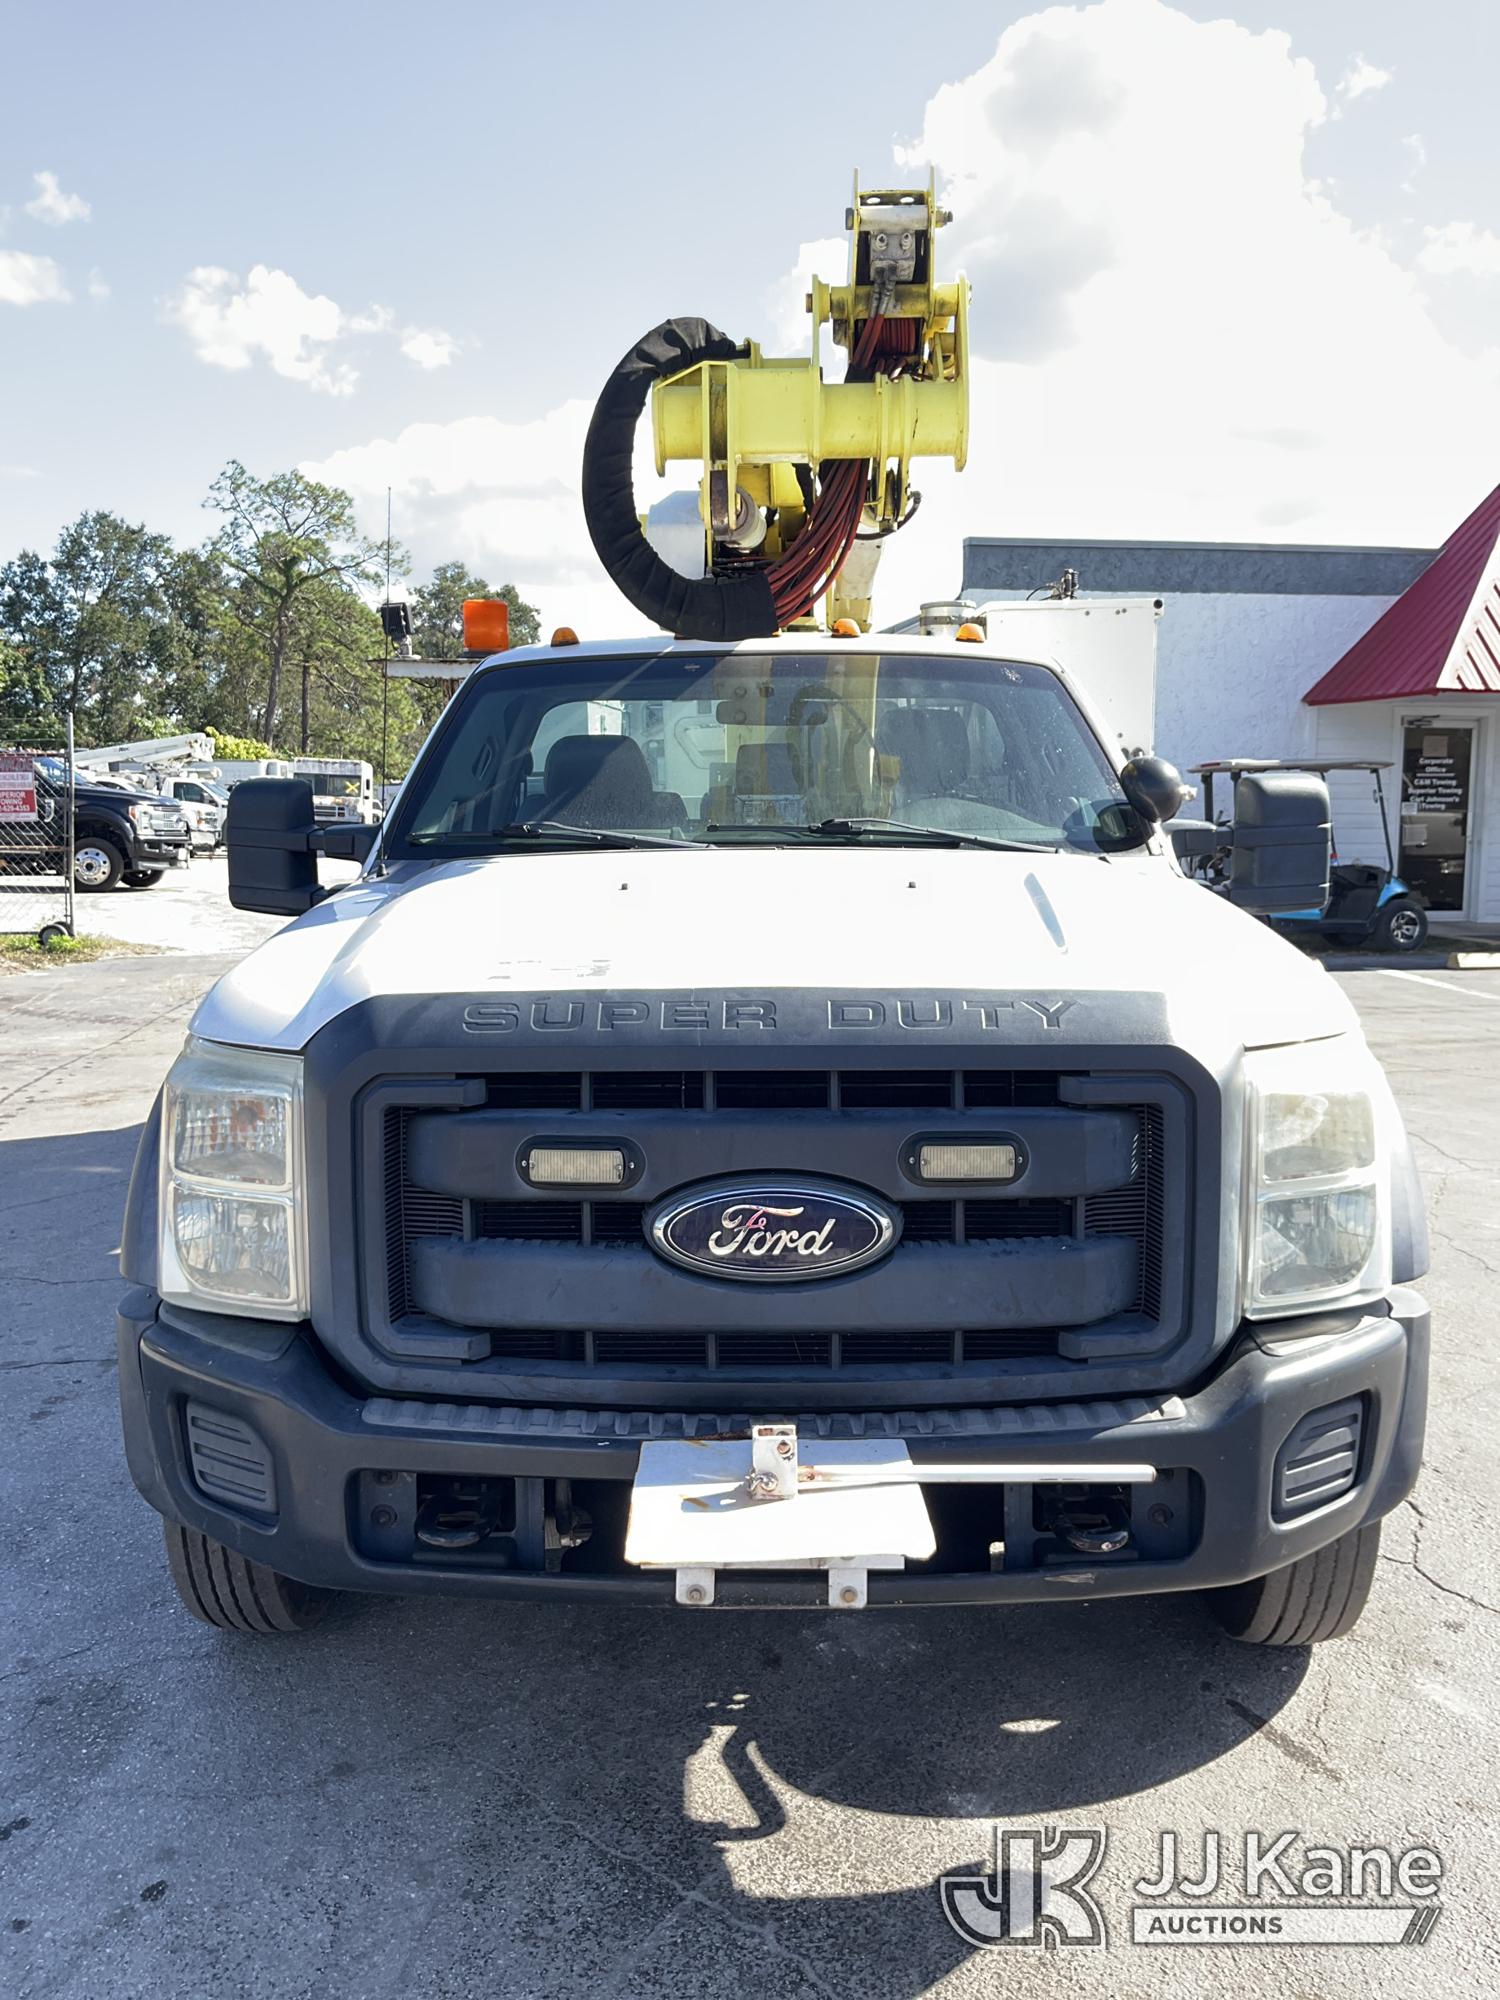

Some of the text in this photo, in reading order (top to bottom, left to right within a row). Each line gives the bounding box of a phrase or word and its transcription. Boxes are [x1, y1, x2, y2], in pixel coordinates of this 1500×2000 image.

[1407, 787, 1463, 796] Superior Towing
[1432, 778, 1457, 787] Towing
[462, 1000, 1079, 1033] SUPER DUTY
[708, 1204, 833, 1257] Ford
